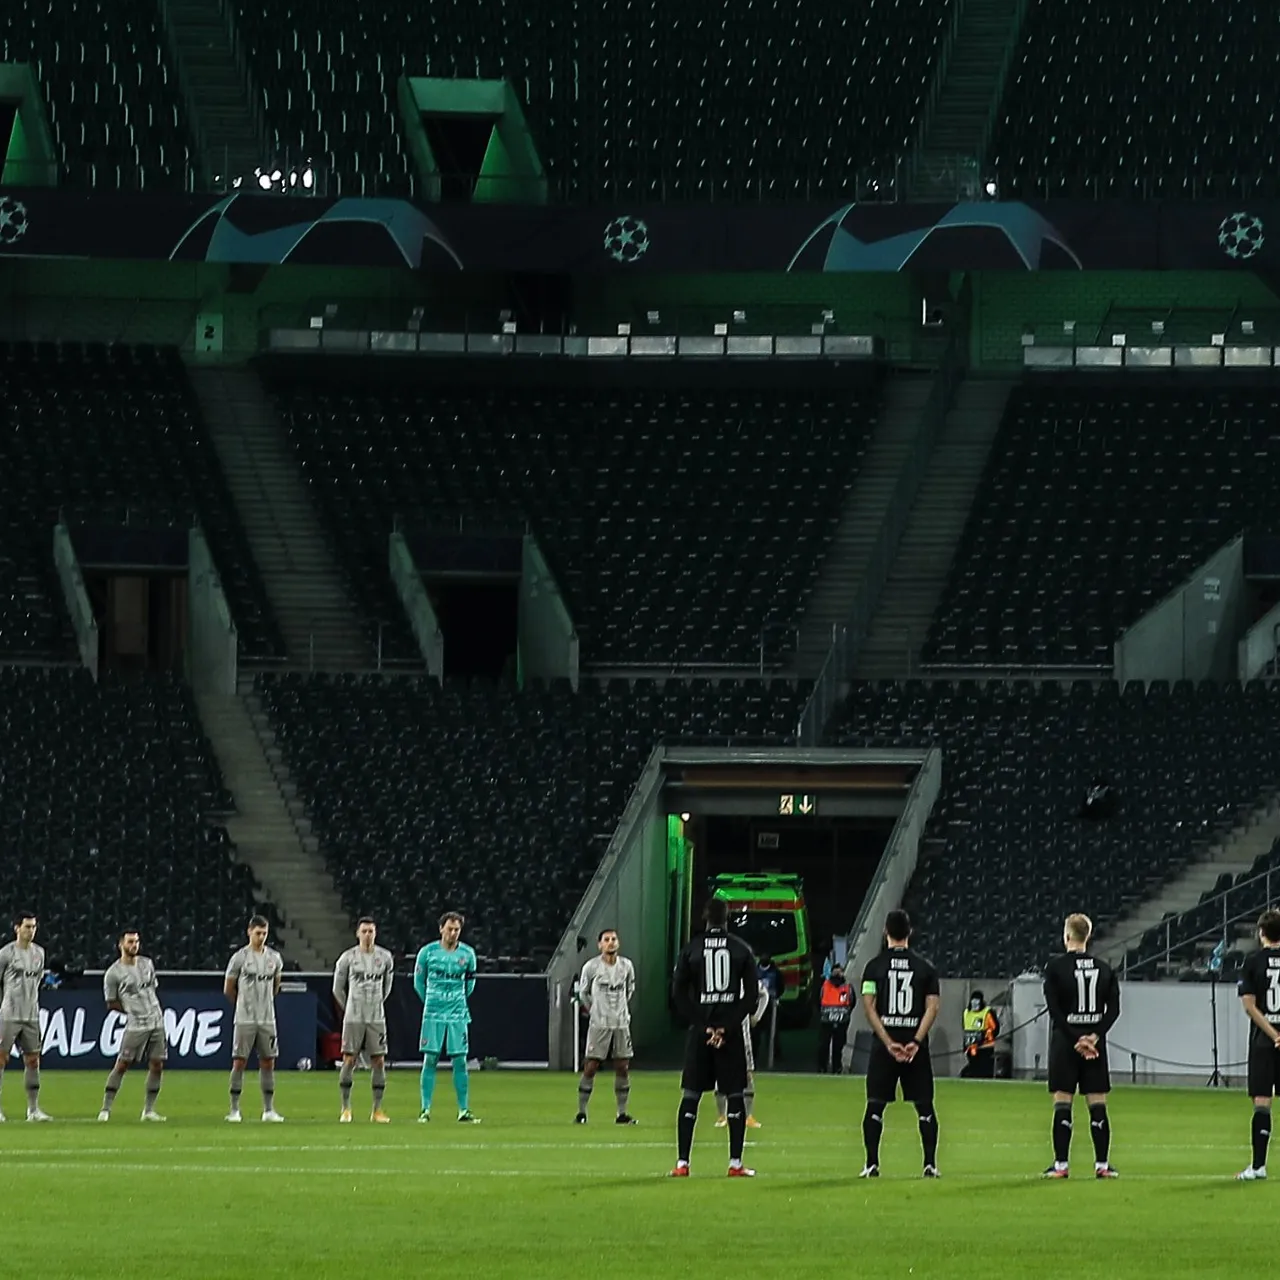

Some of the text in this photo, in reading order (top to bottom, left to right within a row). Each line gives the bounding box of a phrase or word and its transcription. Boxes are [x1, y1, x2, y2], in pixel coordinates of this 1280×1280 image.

[204, 324, 215, 339] 2
[703, 948, 731, 992] 10
[887, 969, 914, 1015] 13
[1074, 968, 1099, 1013] 17
